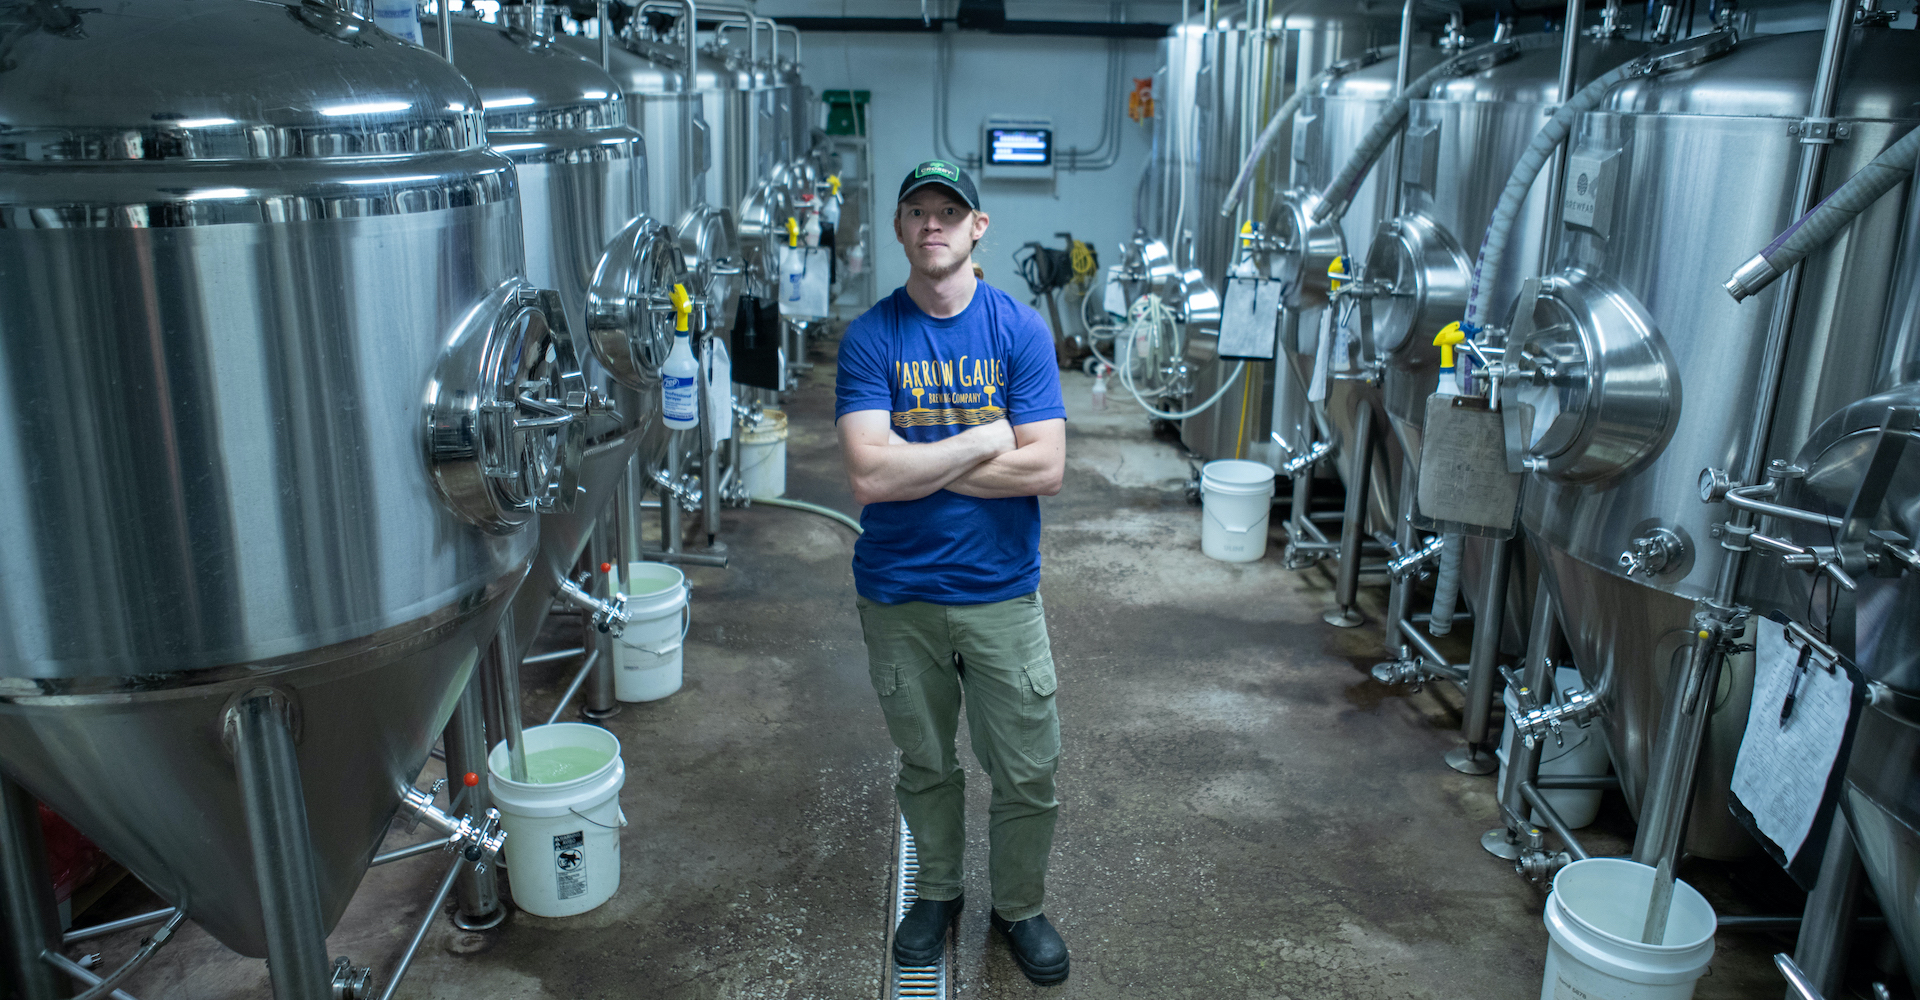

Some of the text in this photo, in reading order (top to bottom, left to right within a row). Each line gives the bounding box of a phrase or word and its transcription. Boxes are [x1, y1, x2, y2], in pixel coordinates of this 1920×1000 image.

[1565, 200, 1594, 213] BREWFAB
[665, 391, 692, 399] Professional
[929, 392, 981, 404] BREWING COMPANY
